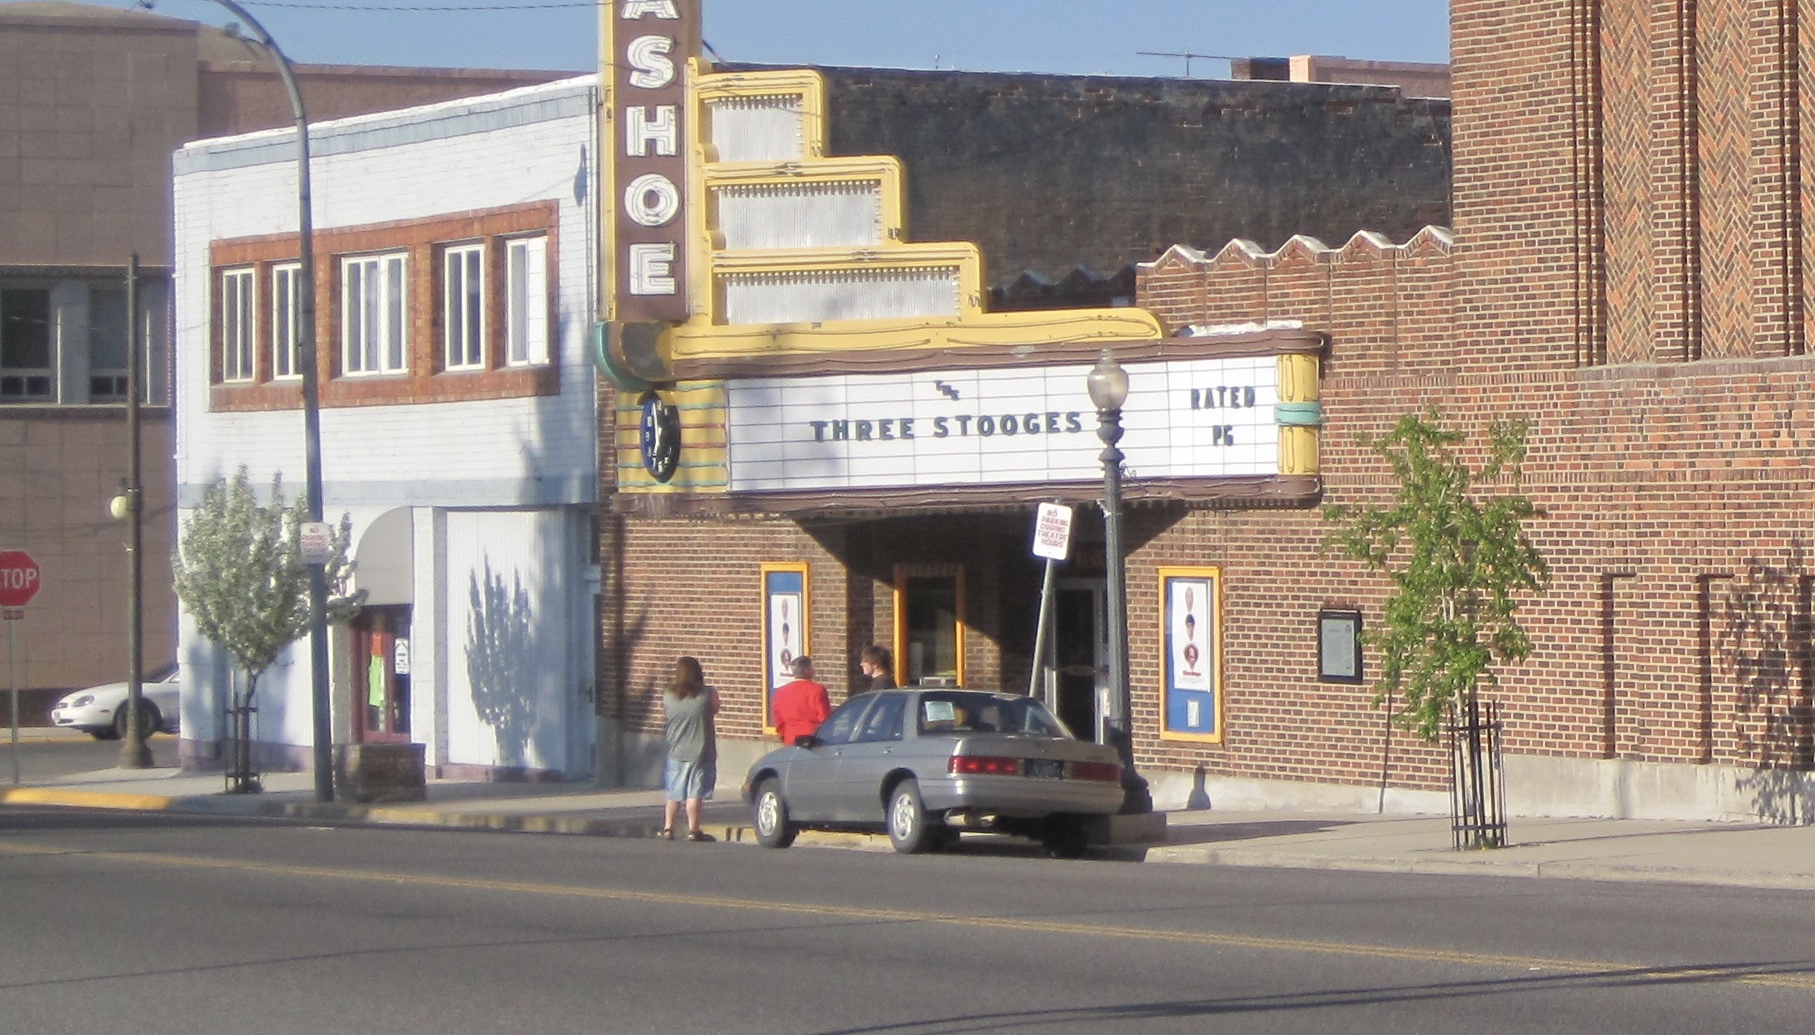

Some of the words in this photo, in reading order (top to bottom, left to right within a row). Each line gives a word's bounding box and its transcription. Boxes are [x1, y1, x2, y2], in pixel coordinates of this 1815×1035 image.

[1190, 386, 1255, 410] RATED
[810, 418, 914, 443] THREE
[932, 412, 1082, 437] STOOGES
[1212, 425, 1234, 447] PG
[0, 568, 37, 589] TOP
